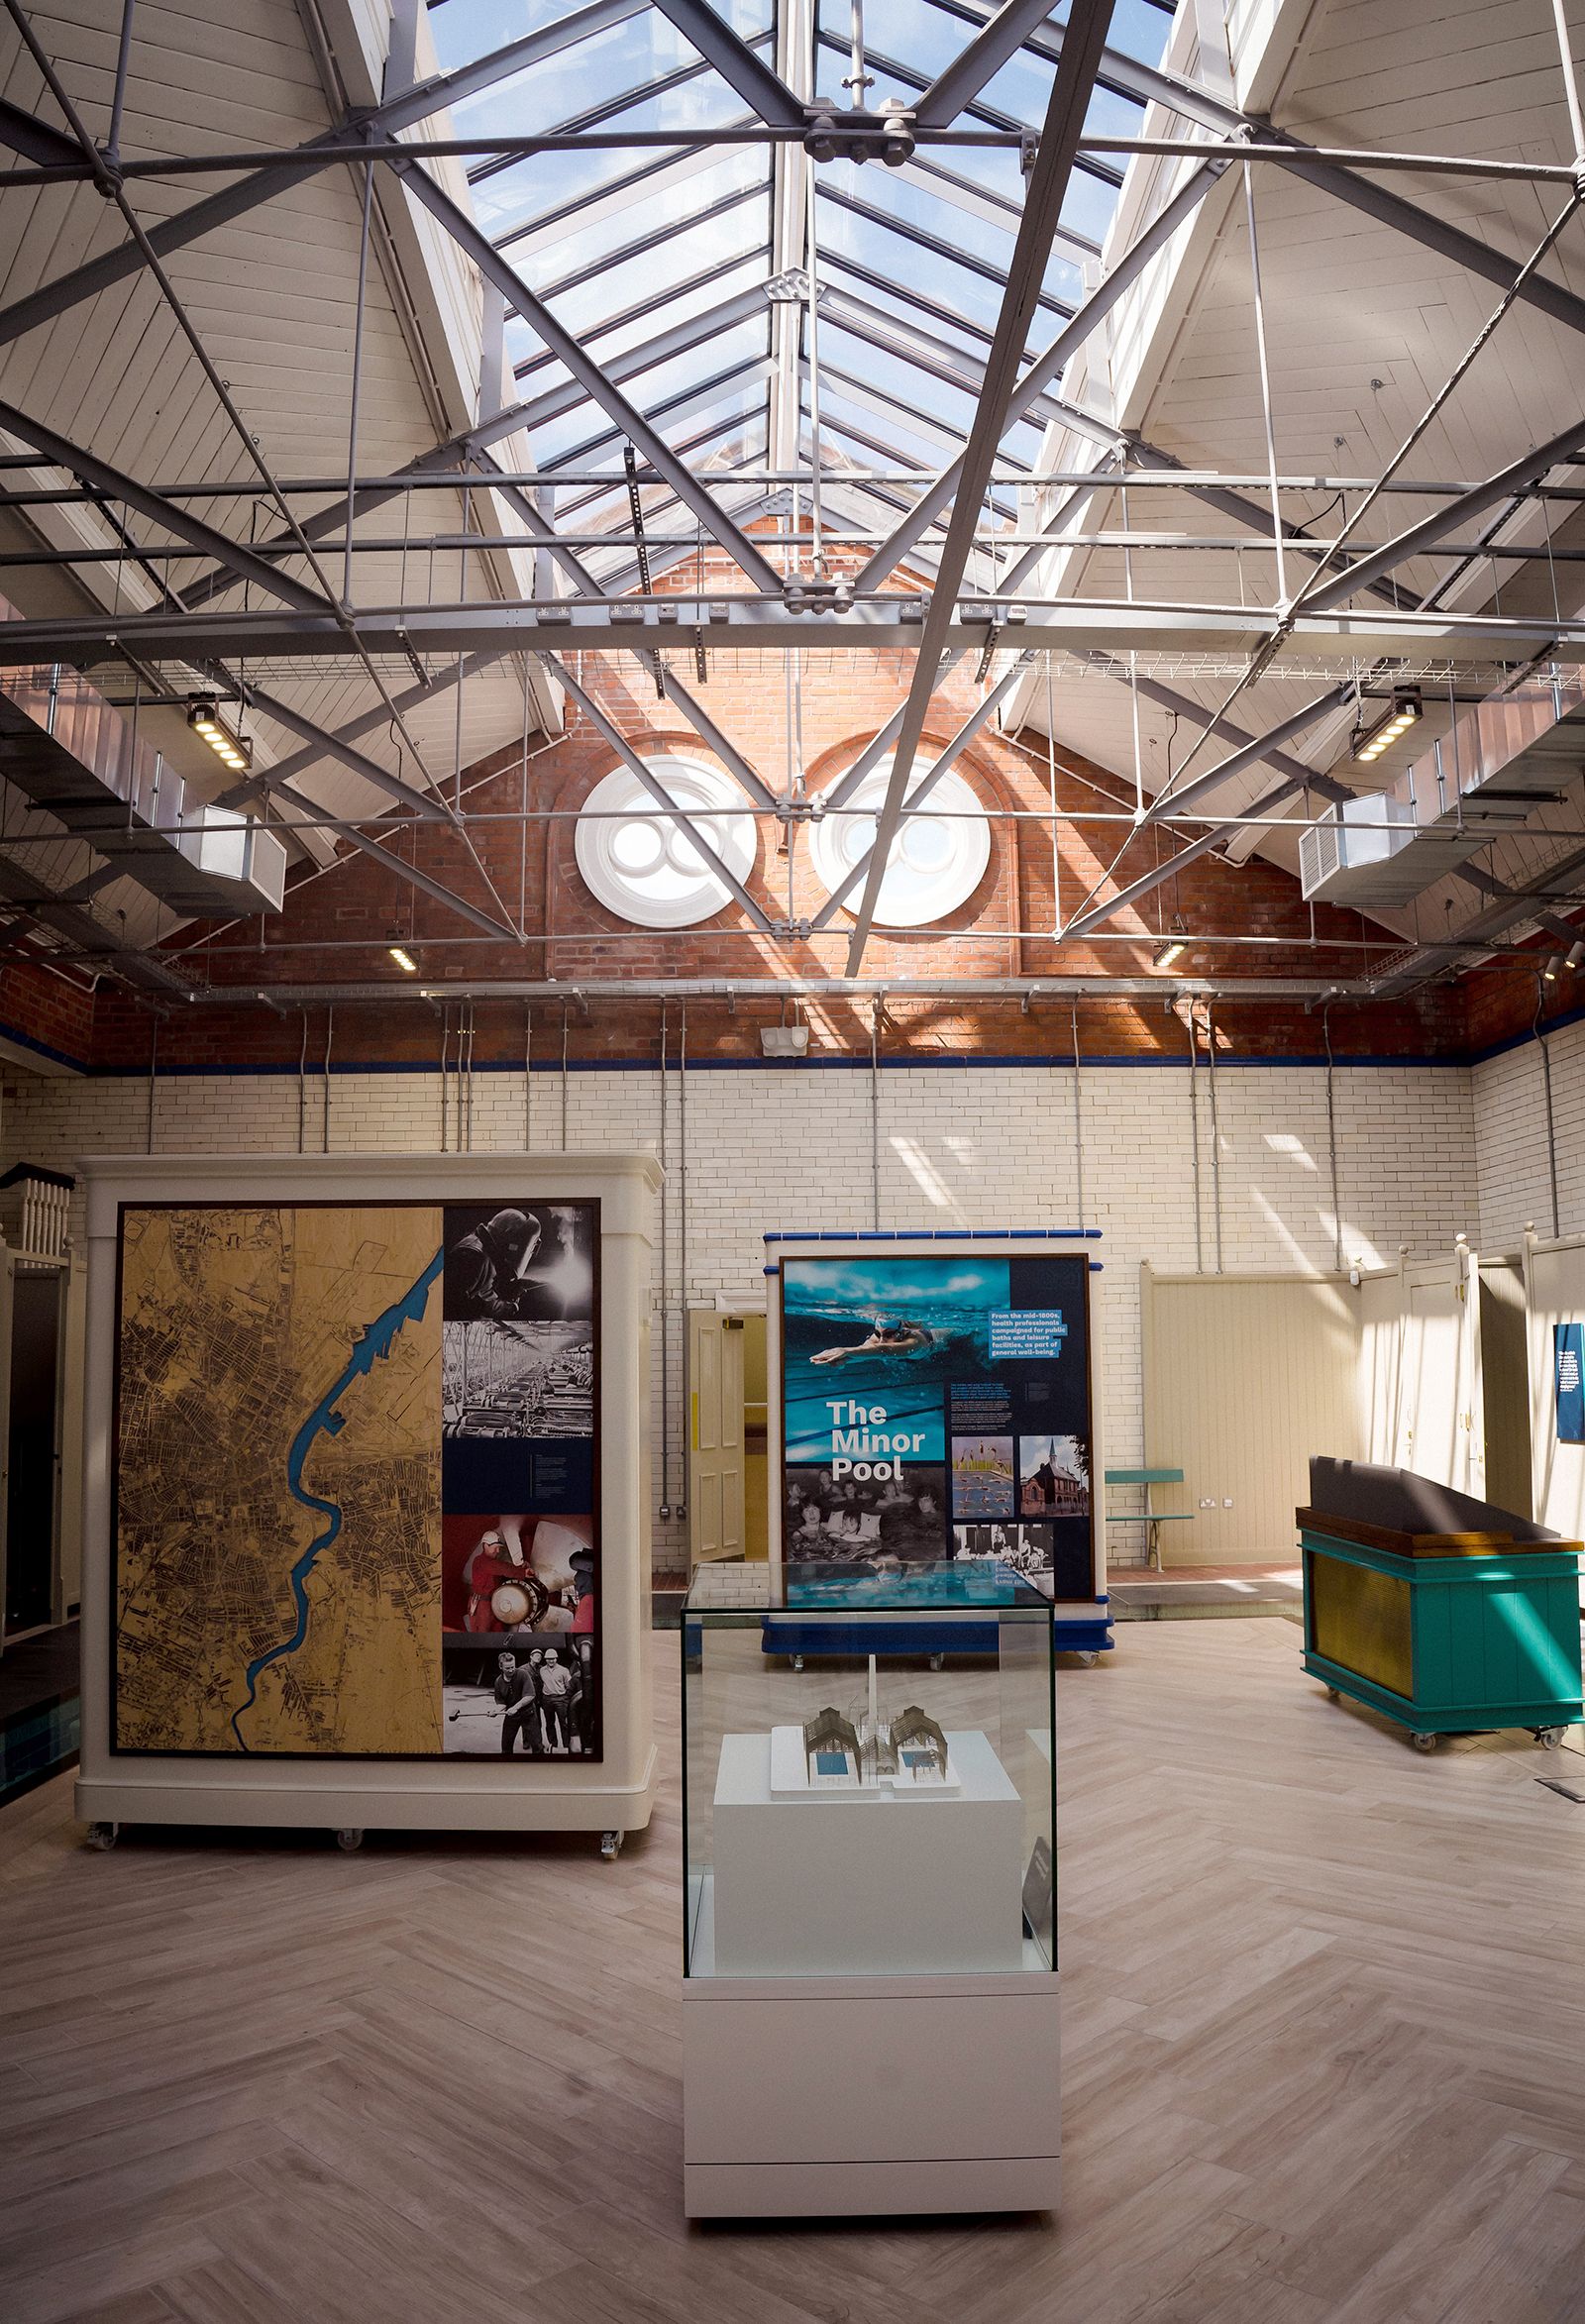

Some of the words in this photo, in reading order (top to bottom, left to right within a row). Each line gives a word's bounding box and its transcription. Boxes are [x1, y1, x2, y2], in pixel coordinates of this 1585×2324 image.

[826, 1400, 888, 1425] The
[832, 1427, 926, 1452] Minor
[832, 1455, 904, 1481] Pool
